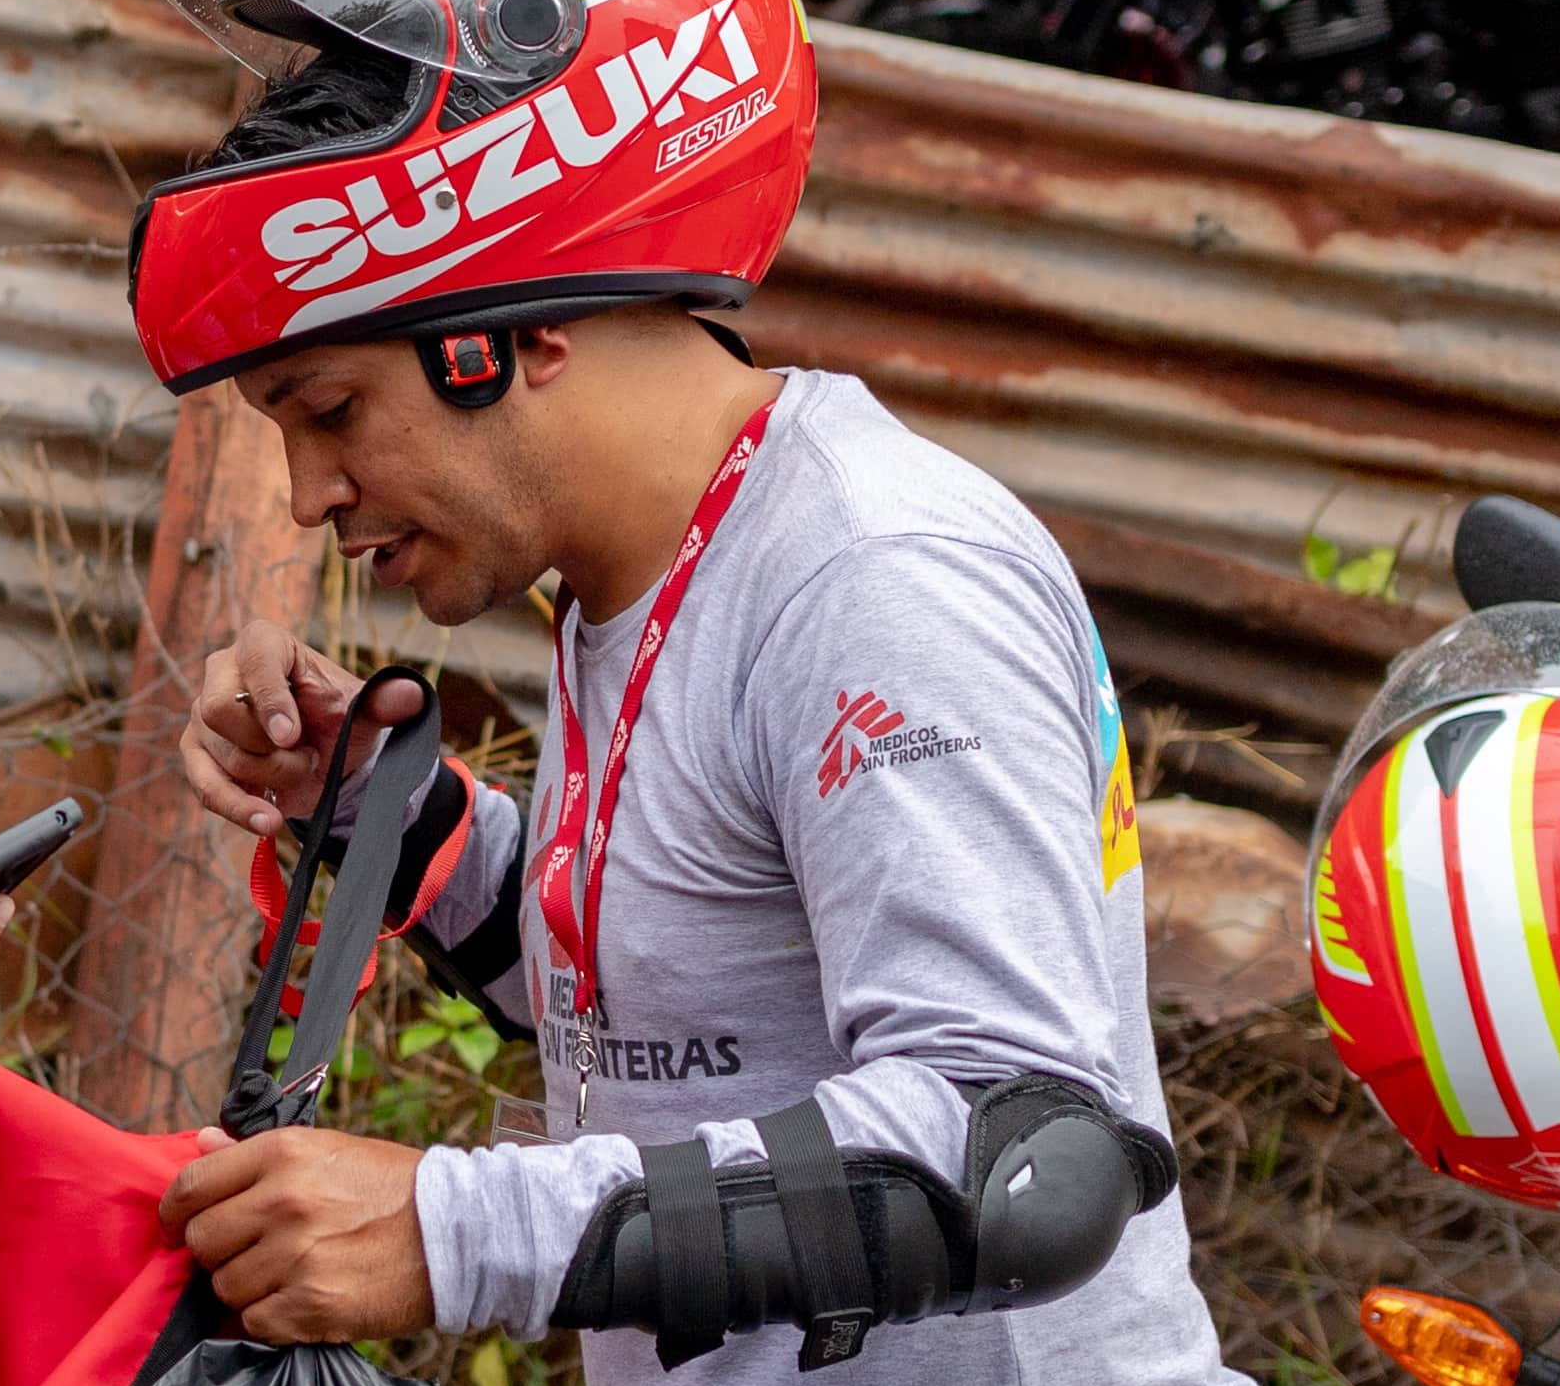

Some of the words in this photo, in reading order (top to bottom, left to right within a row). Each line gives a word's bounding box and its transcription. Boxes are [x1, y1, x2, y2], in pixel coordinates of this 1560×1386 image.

[655, 87, 775, 172] ECSTAR
[860, 754, 885, 774] SIN
[889, 736, 982, 766] FRONTERAS
[868, 725, 939, 754] MEDICOS
